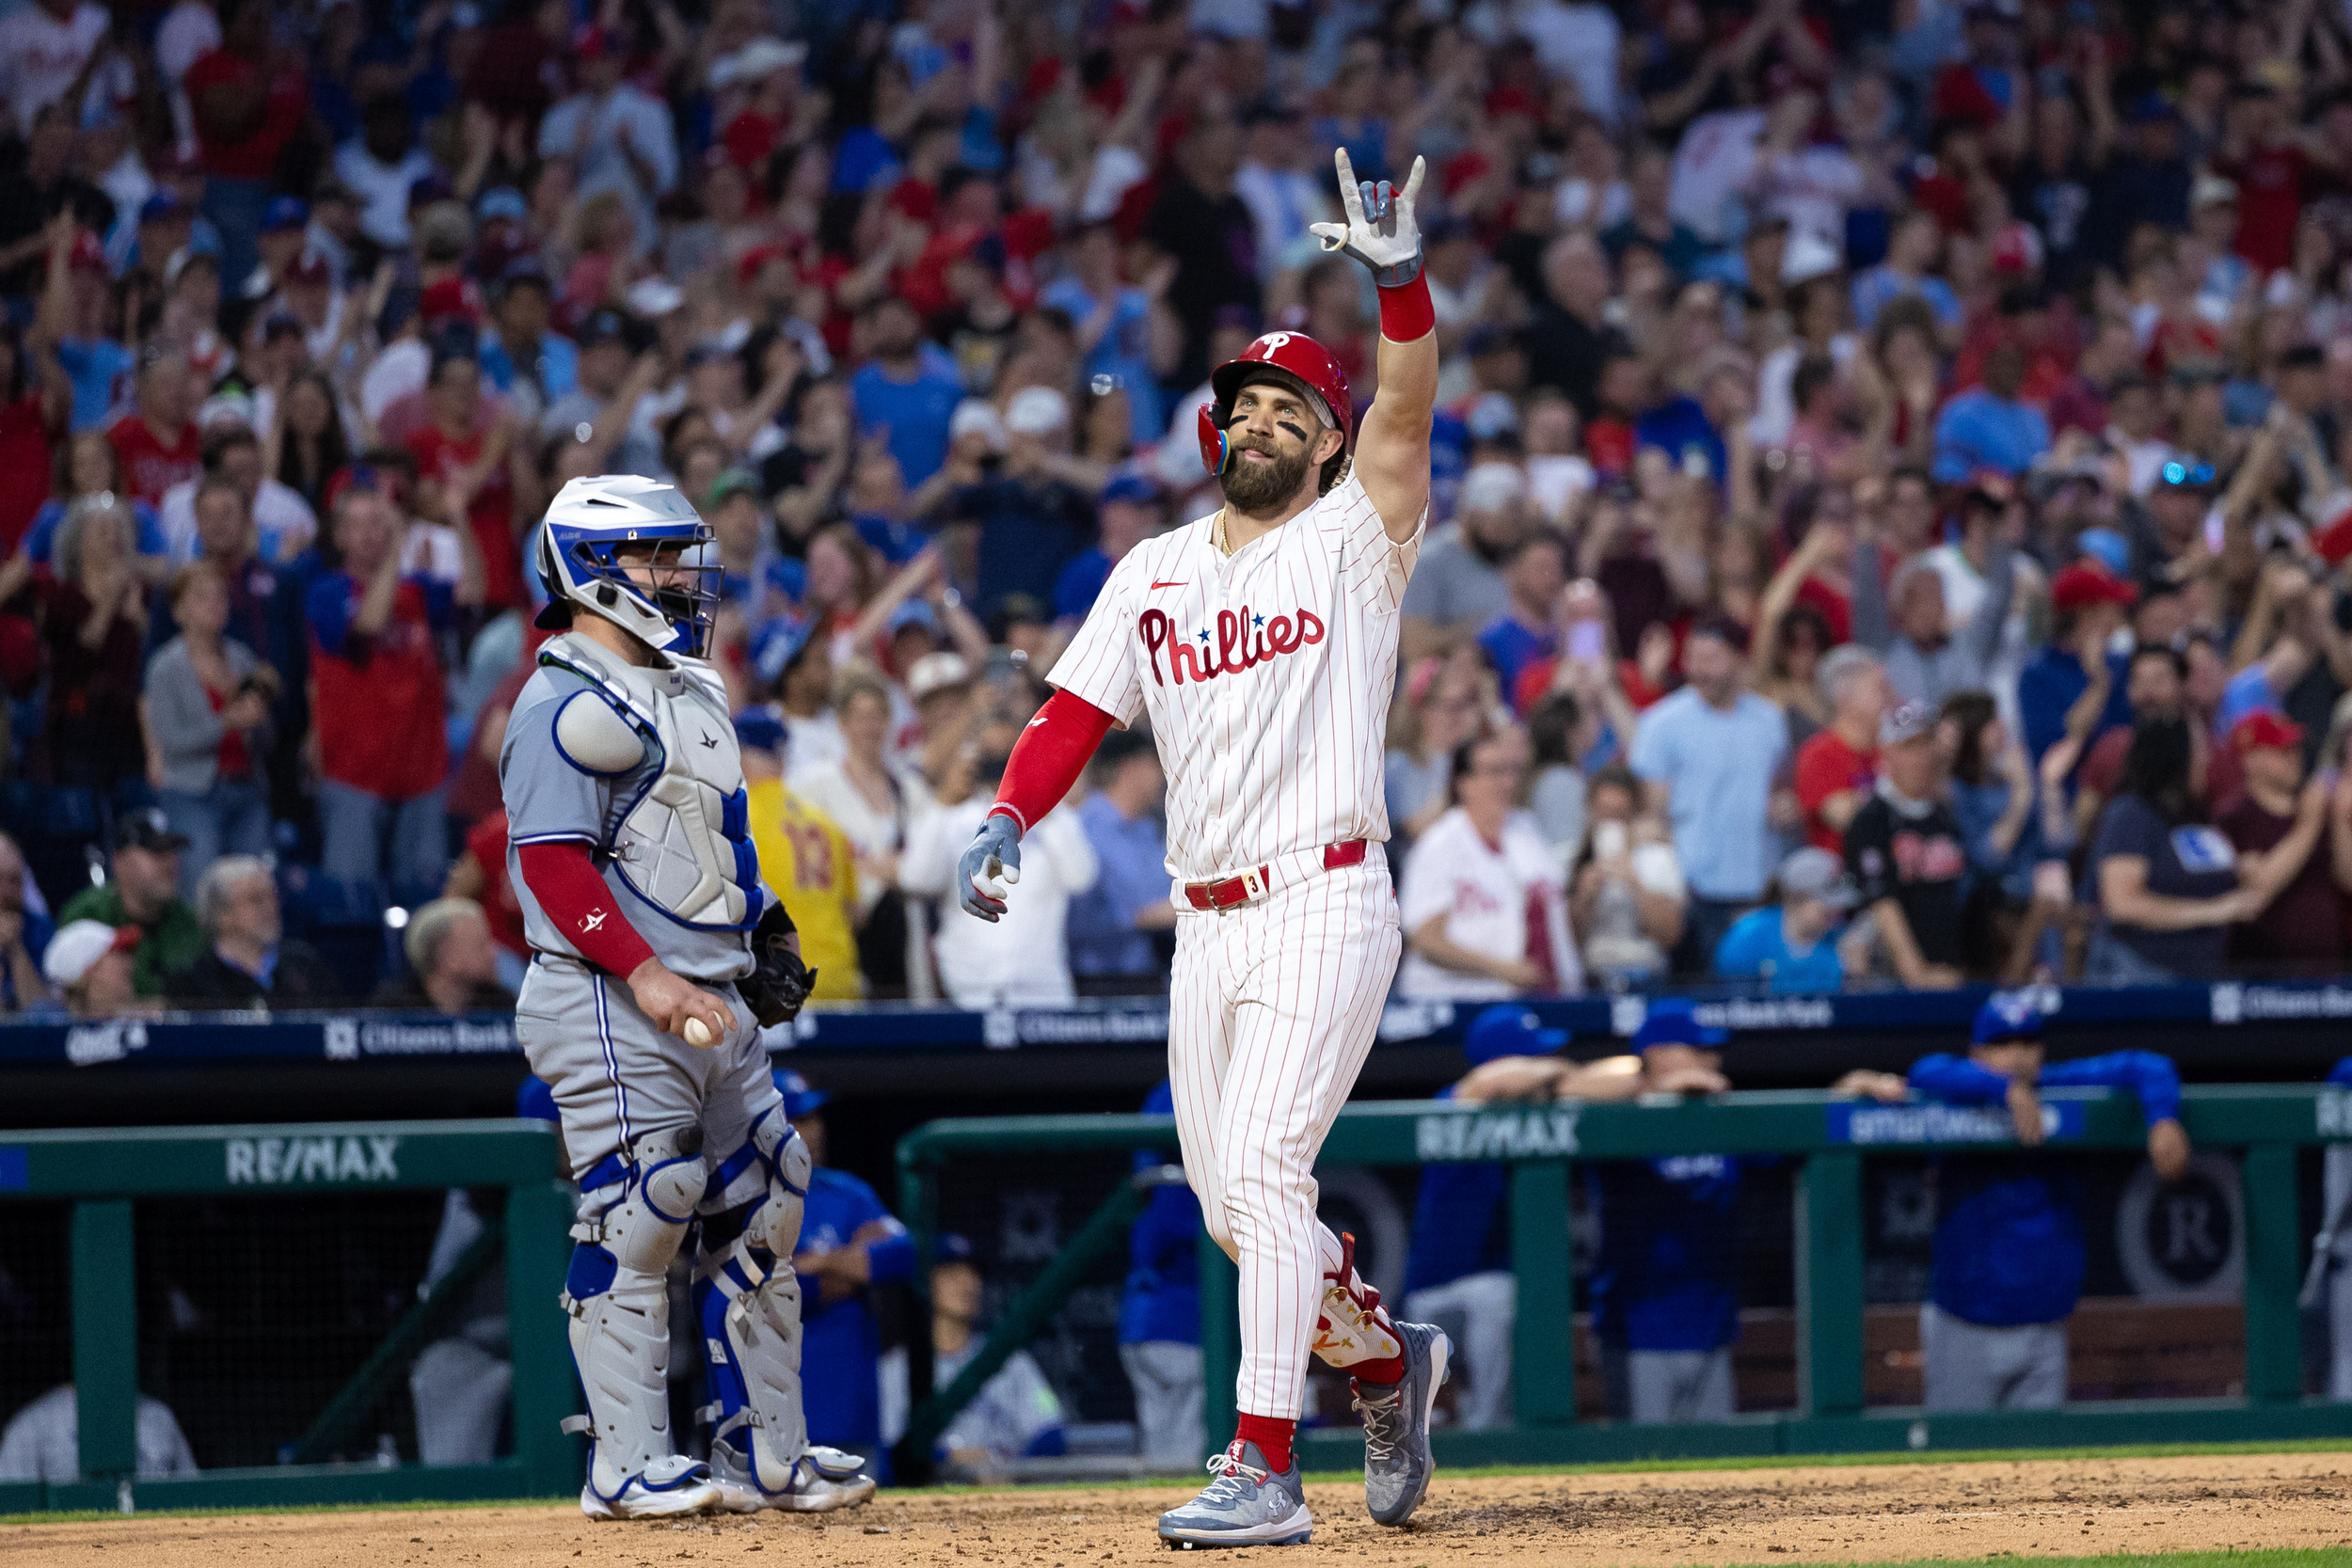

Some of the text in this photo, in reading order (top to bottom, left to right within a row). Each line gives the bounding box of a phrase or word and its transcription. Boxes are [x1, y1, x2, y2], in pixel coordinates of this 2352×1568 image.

[1261, 333, 1290, 359] P
[1138, 605, 1325, 688] Phillies
[1248, 876, 1259, 893] 3
[226, 1136, 399, 1182] RE/MAX
[1416, 1112, 1581, 1160] RE/MAX
